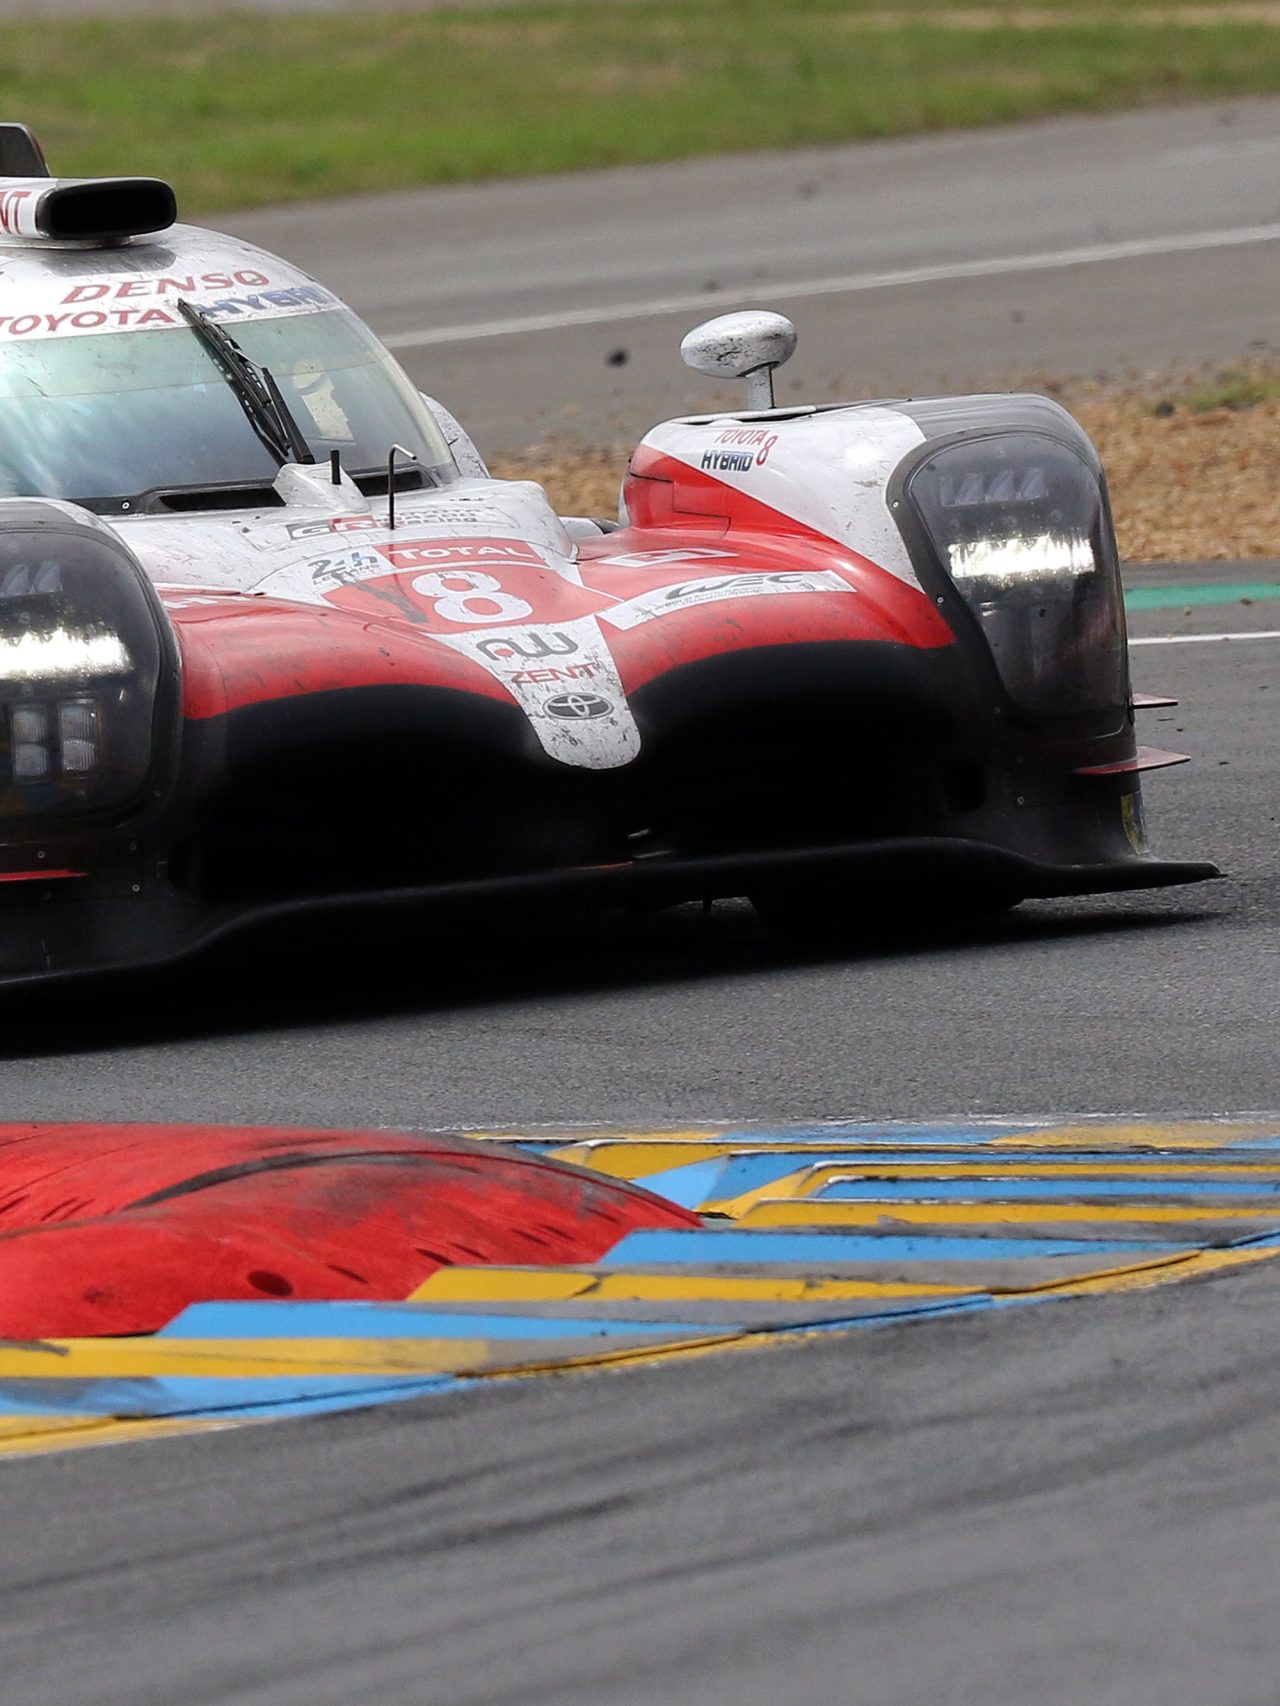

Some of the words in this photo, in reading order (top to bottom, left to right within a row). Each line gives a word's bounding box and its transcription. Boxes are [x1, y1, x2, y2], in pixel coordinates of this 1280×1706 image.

[61, 269, 270, 305] DENSO
[714, 429, 769, 446] TOYOTA
[701, 450, 755, 472] HYBRID
[388, 546, 534, 561] TOTAL
[411, 570, 533, 623] 8
[503, 661, 596, 684] ZENT
